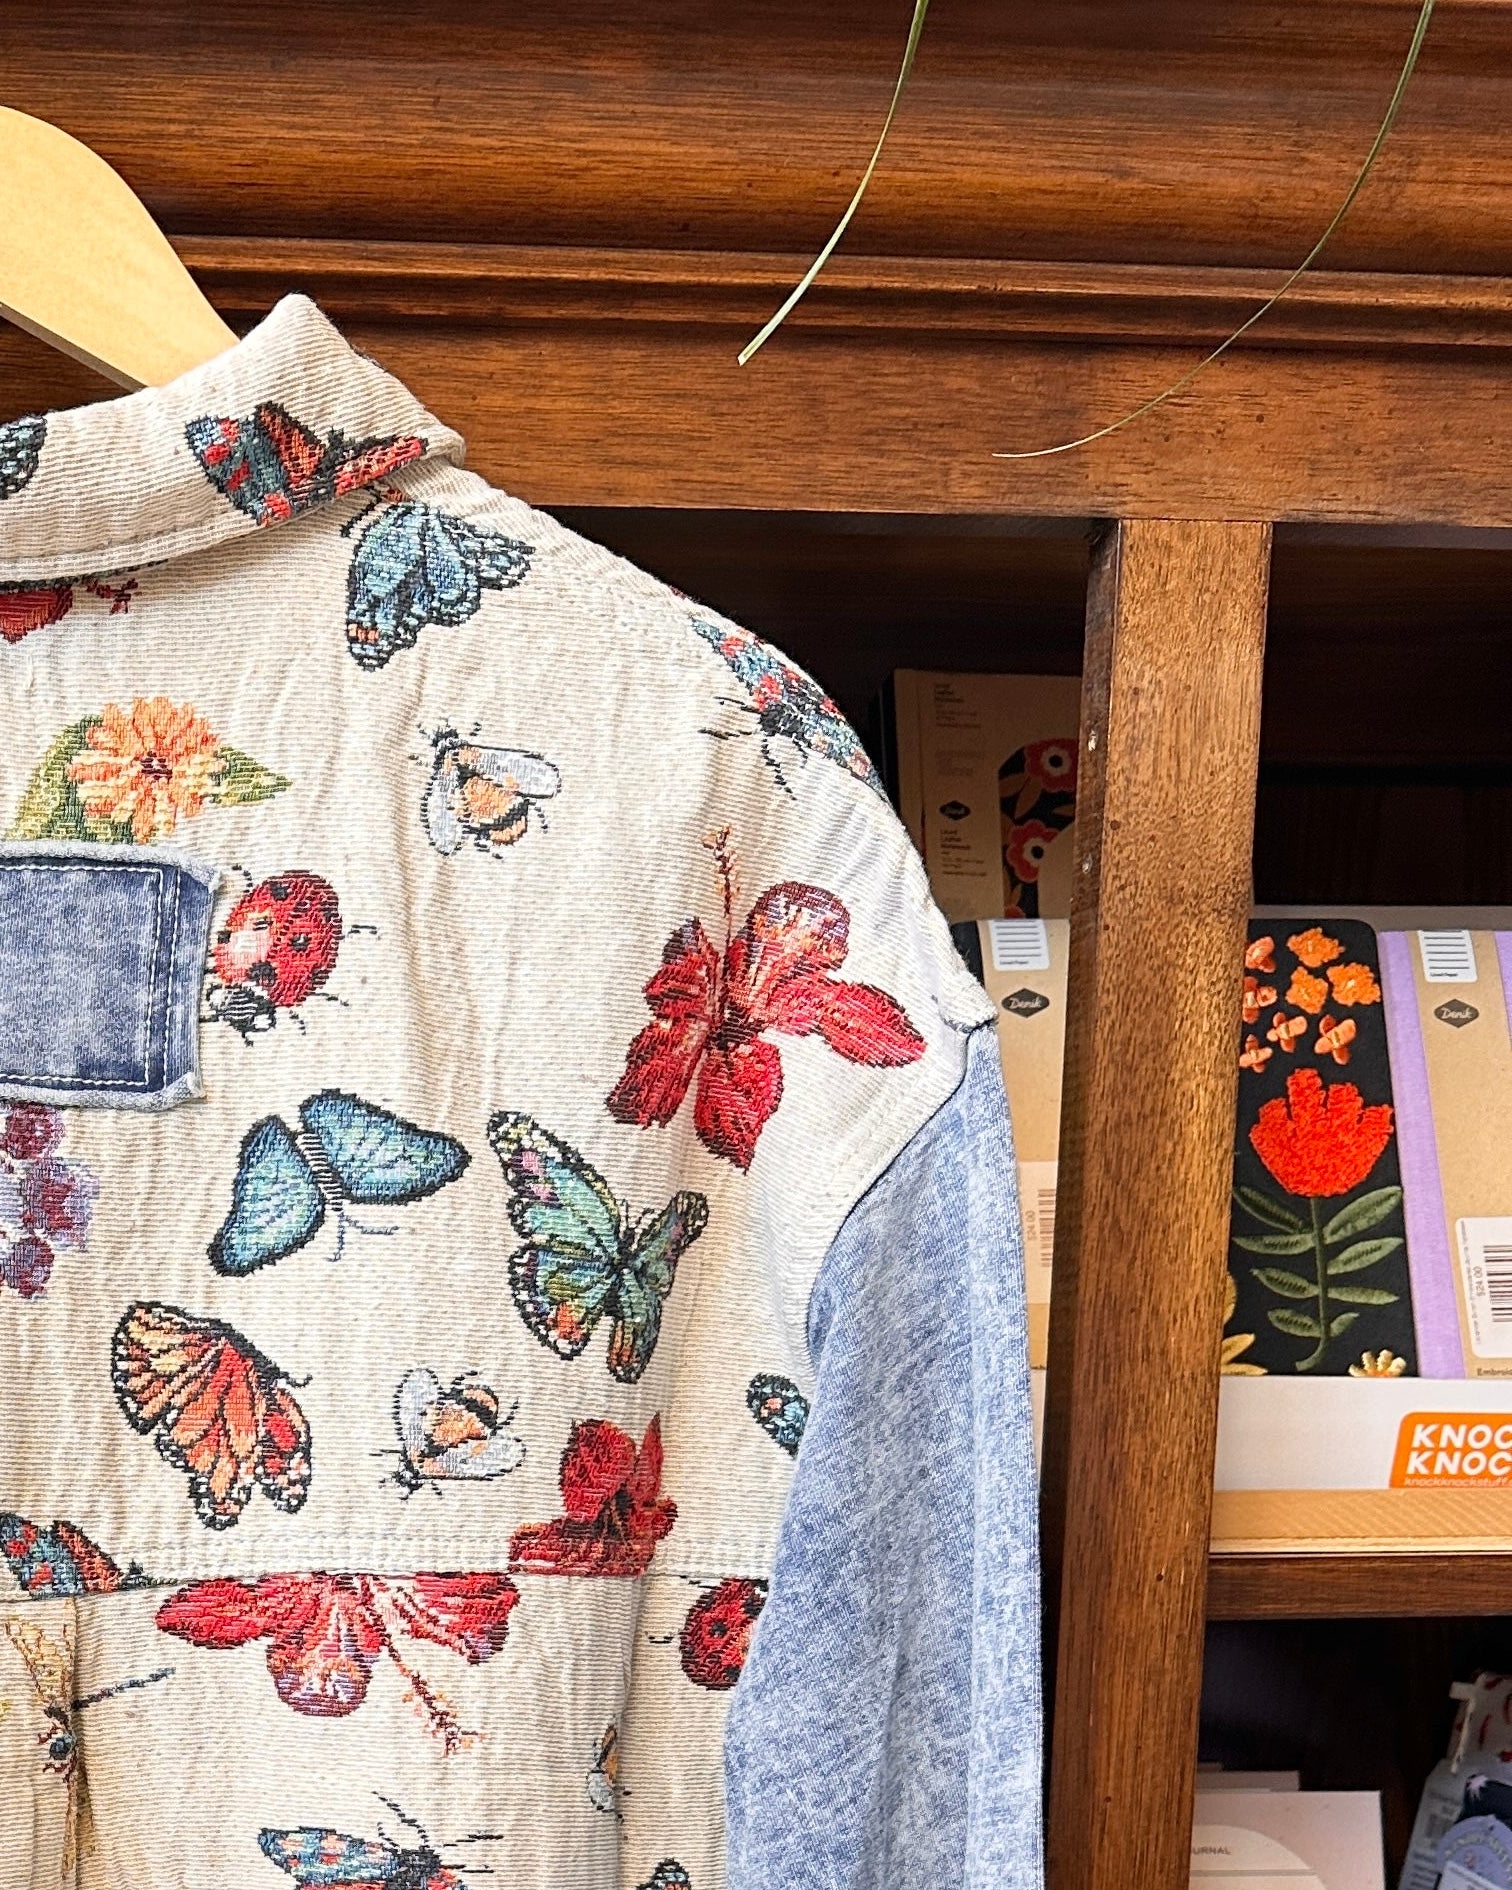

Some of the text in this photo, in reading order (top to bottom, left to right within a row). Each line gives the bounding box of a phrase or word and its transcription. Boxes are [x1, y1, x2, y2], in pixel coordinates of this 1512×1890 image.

[1009, 997, 1042, 1010] Denik
[1441, 1007, 1473, 1019] Denik
[1411, 1423, 1512, 1450] KNOC
[1406, 1450, 1512, 1476] KNOC
